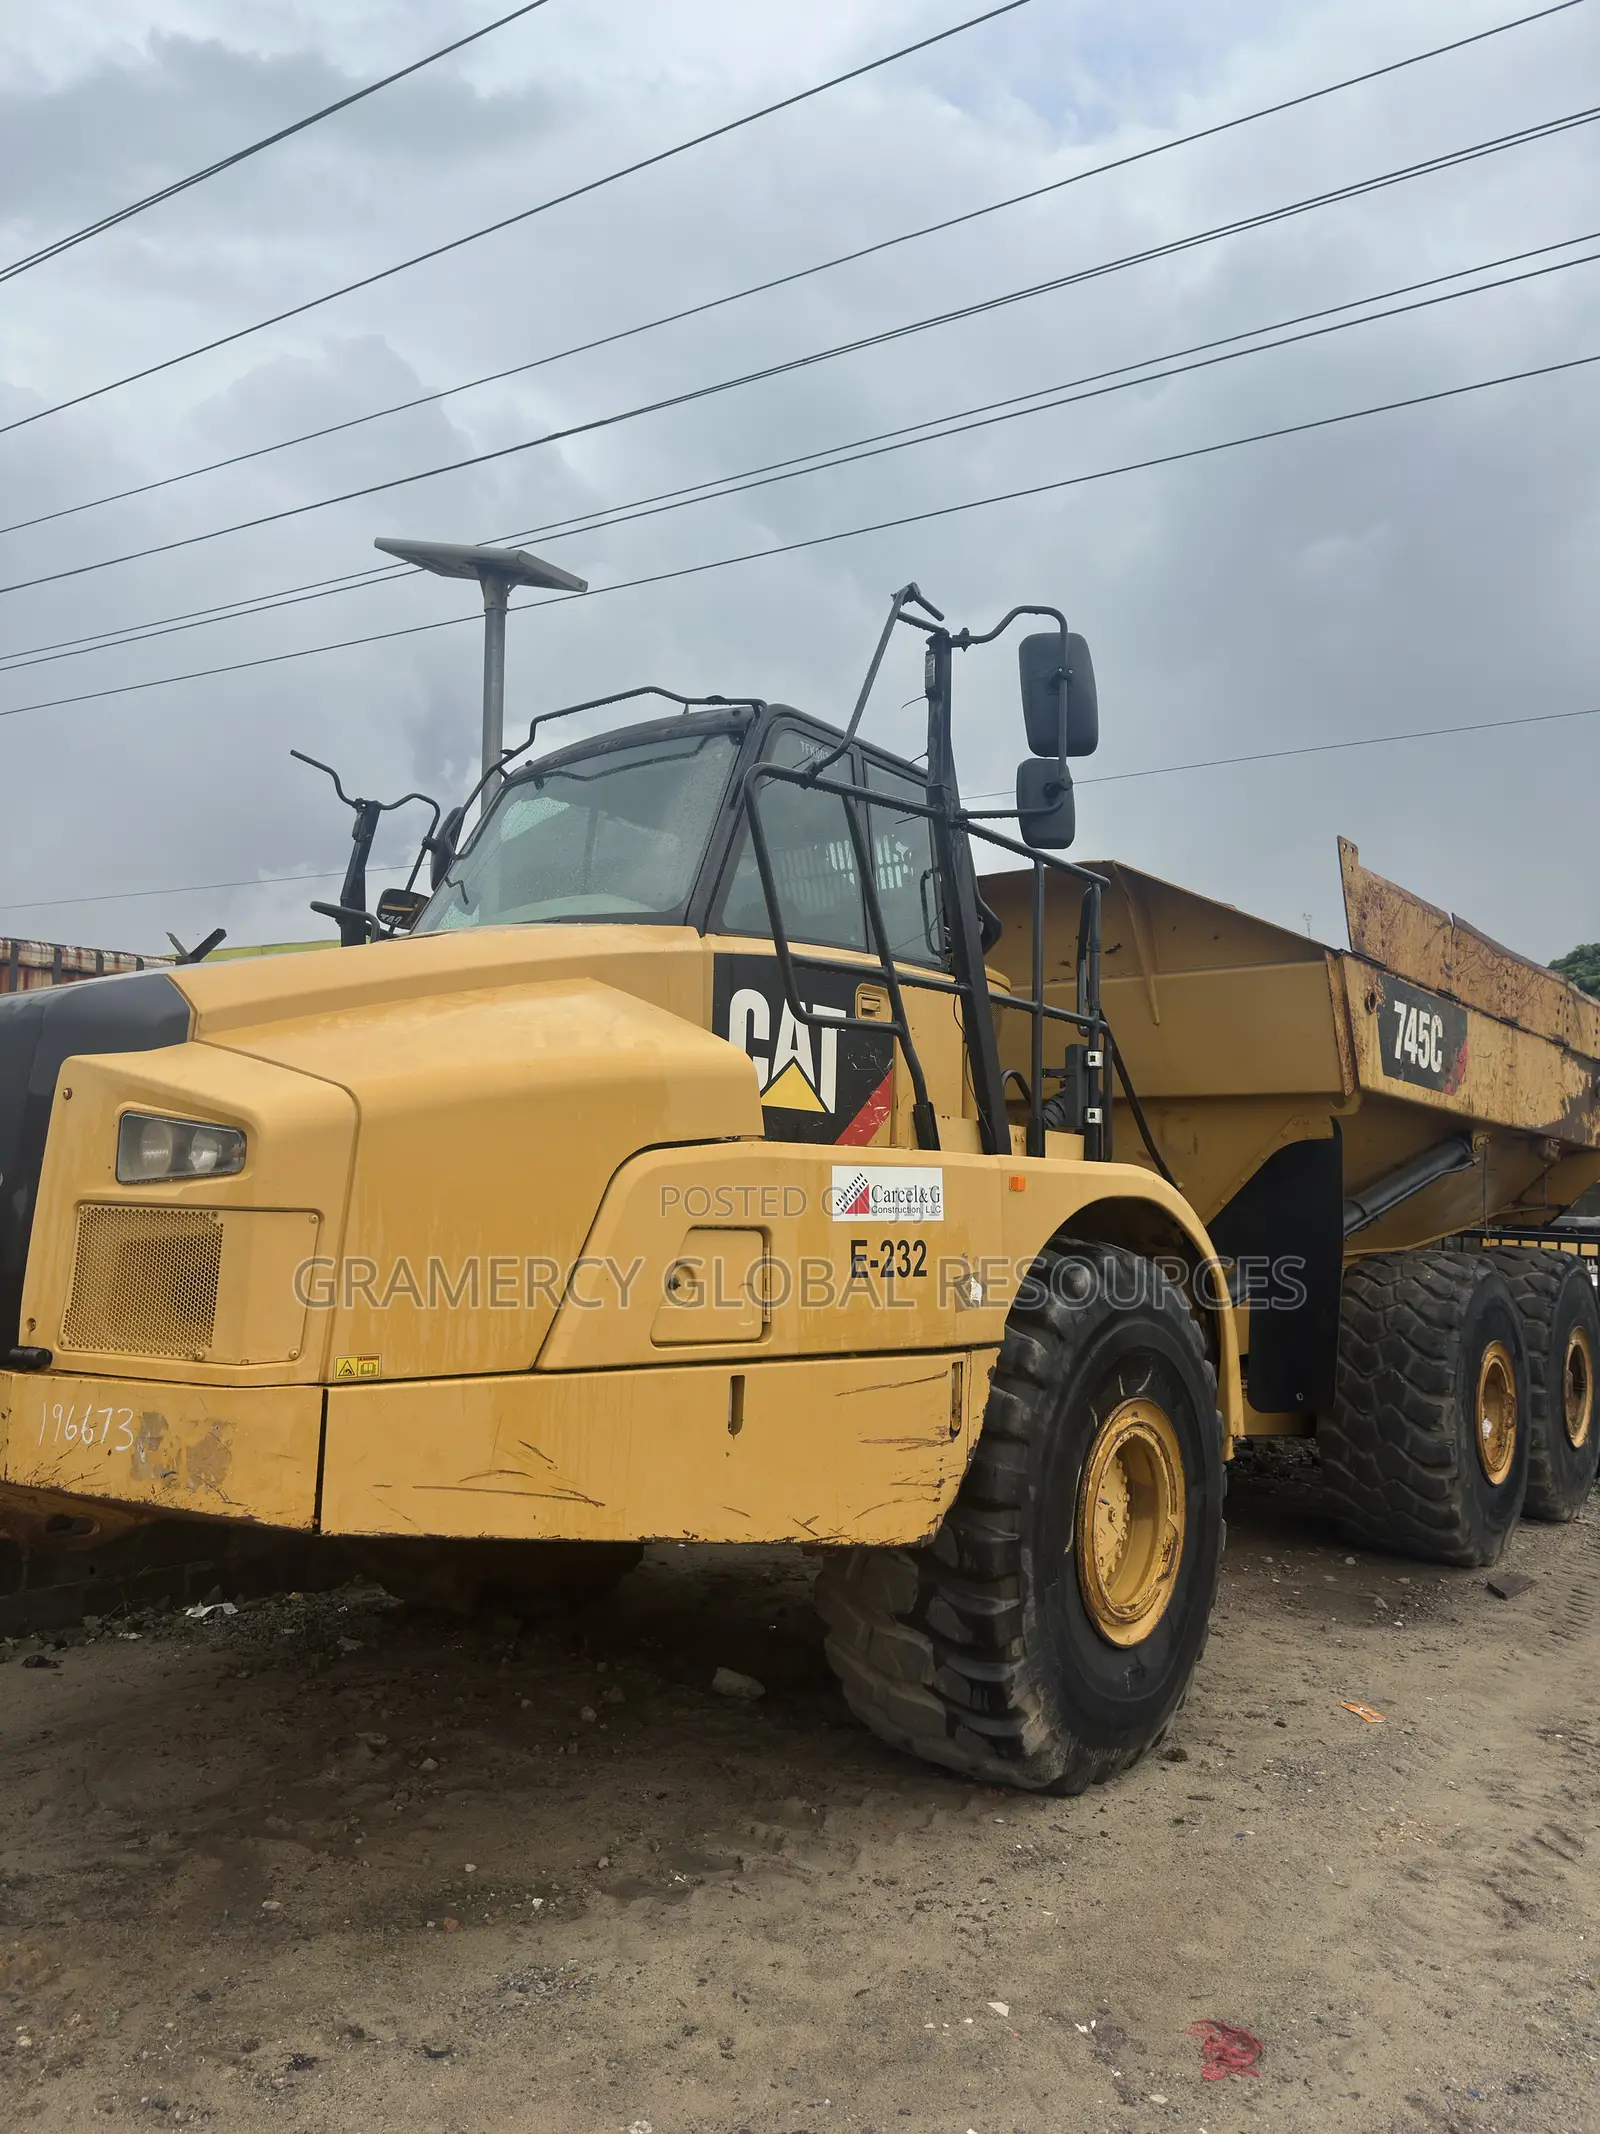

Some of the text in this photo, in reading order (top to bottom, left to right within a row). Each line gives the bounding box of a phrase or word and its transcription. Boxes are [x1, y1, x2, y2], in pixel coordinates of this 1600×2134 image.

[729, 989, 846, 1114] CAT
[1394, 1000, 1443, 1073] 745C
[871, 1184, 941, 1204] Carcel&G
[925, 1205, 942, 1214] LLC
[850, 1239, 928, 1278] E-232
[38, 1402, 134, 1452] 196673
